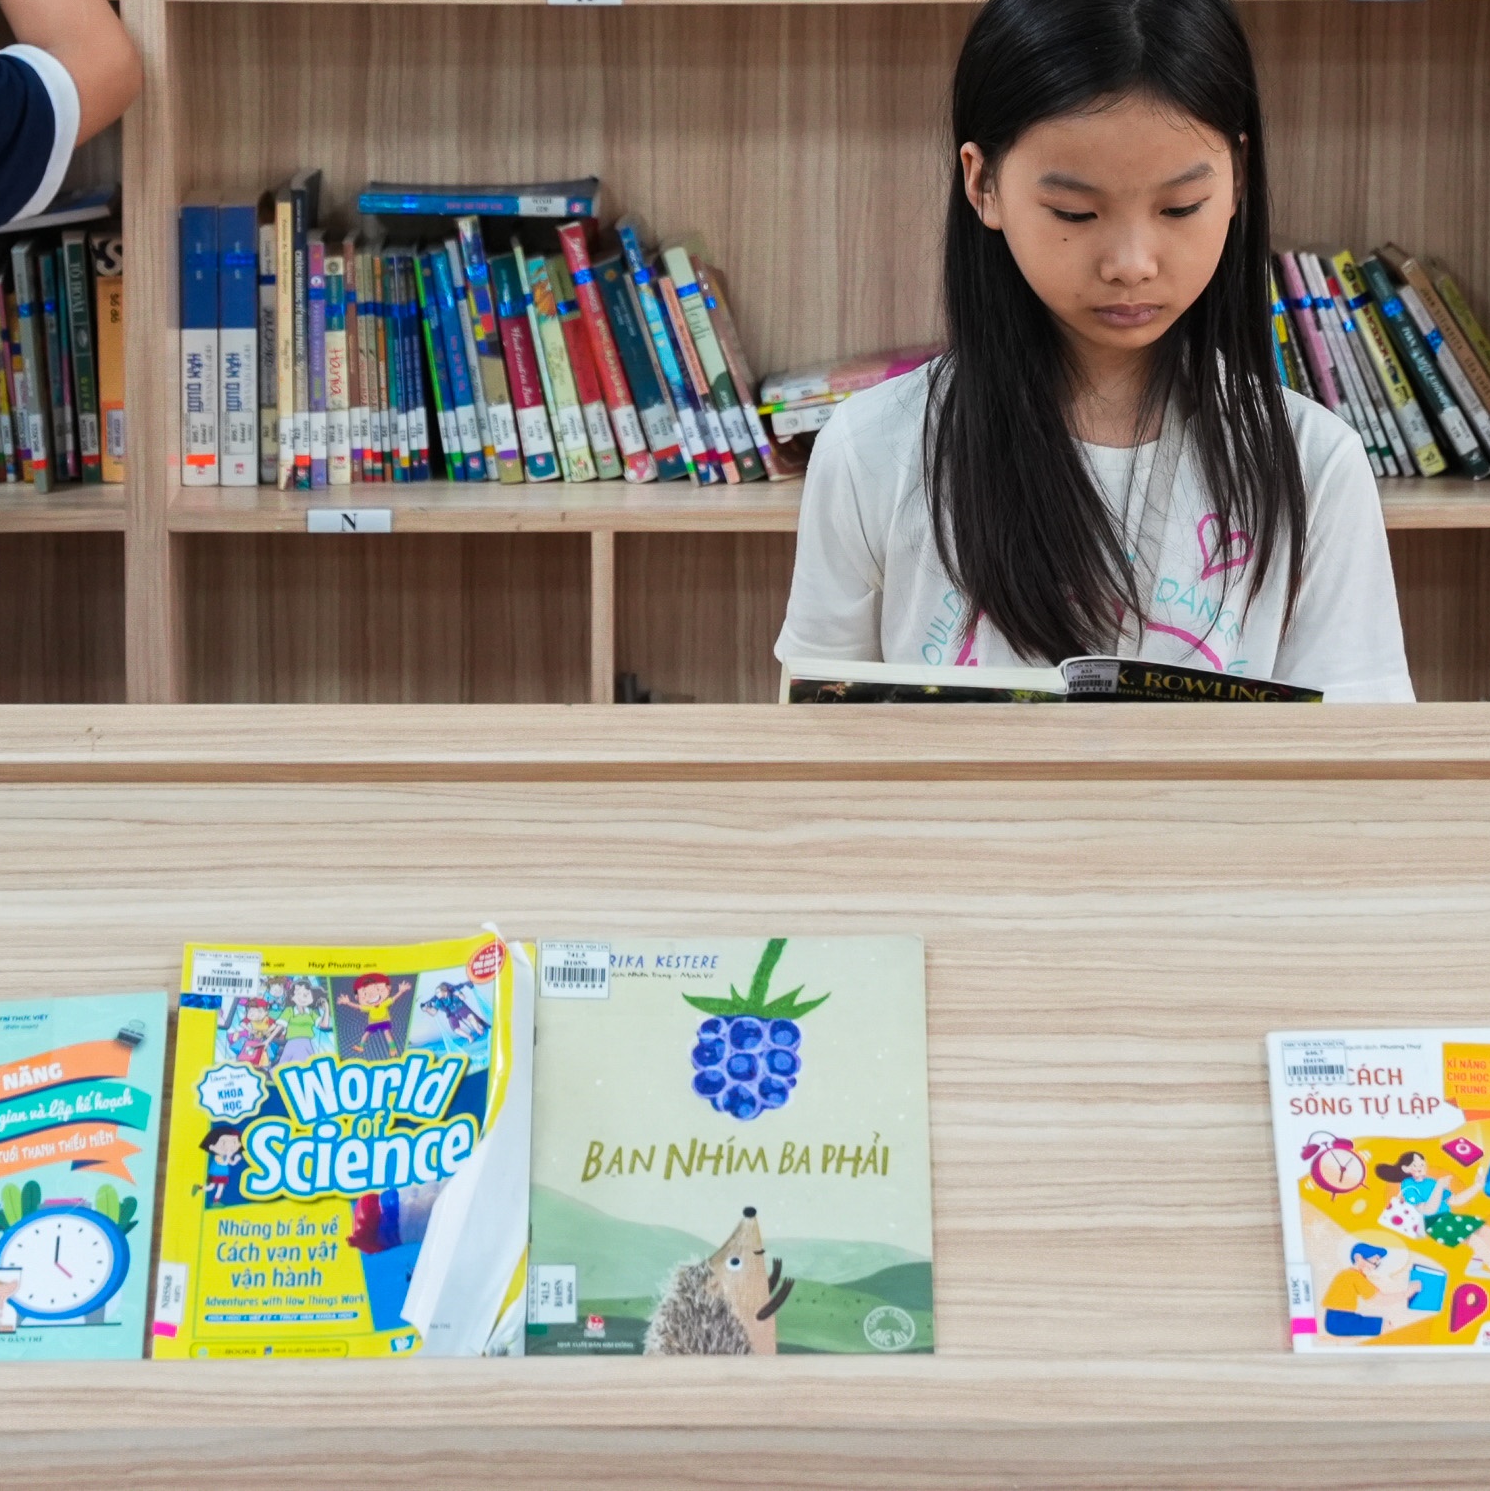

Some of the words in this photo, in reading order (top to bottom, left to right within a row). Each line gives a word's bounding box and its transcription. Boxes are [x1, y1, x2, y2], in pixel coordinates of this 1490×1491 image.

[341, 513, 358, 532] N
[1155, 576, 1242, 648] DANCE
[1144, 671, 1280, 702] ROWLING
[308, 960, 325, 970] Huy
[654, 954, 720, 970] KESTERE
[1459, 1058, 1488, 1071] NĂNG
[283, 1056, 464, 1120] World
[1447, 1071, 1466, 1082] CHO
[1469, 1072, 1490, 1085] HỌC
[94, 1088, 134, 1114] hoạch
[217, 1087, 245, 1101] KHOA
[1453, 1084, 1488, 1096] TRUNG
[221, 1098, 244, 1114] HỌC
[1289, 1091, 1352, 1116] SỐNG
[1359, 1094, 1391, 1120] TỰ
[1397, 1093, 1441, 1121] LẬP
[357, 1109, 384, 1138] of
[21, 1142, 56, 1162] THANH
[249, 1116, 475, 1194] Science
[581, 1139, 657, 1184] BẠN
[663, 1134, 770, 1181] NHÍM
[777, 1140, 812, 1176] BA
[820, 1130, 891, 1179] PHẢI
[217, 1218, 273, 1241] Những
[275, 1216, 292, 1237] bí
[215, 1241, 260, 1263] Cách
[267, 1243, 303, 1264] vạn
[308, 1241, 340, 1264] vật
[230, 1266, 266, 1290] vận
[272, 1265, 324, 1287] hành
[204, 1294, 260, 1307] Adventures
[261, 1293, 284, 1307] with
[308, 1292, 340, 1308] Things
[341, 1291, 366, 1305] Work
